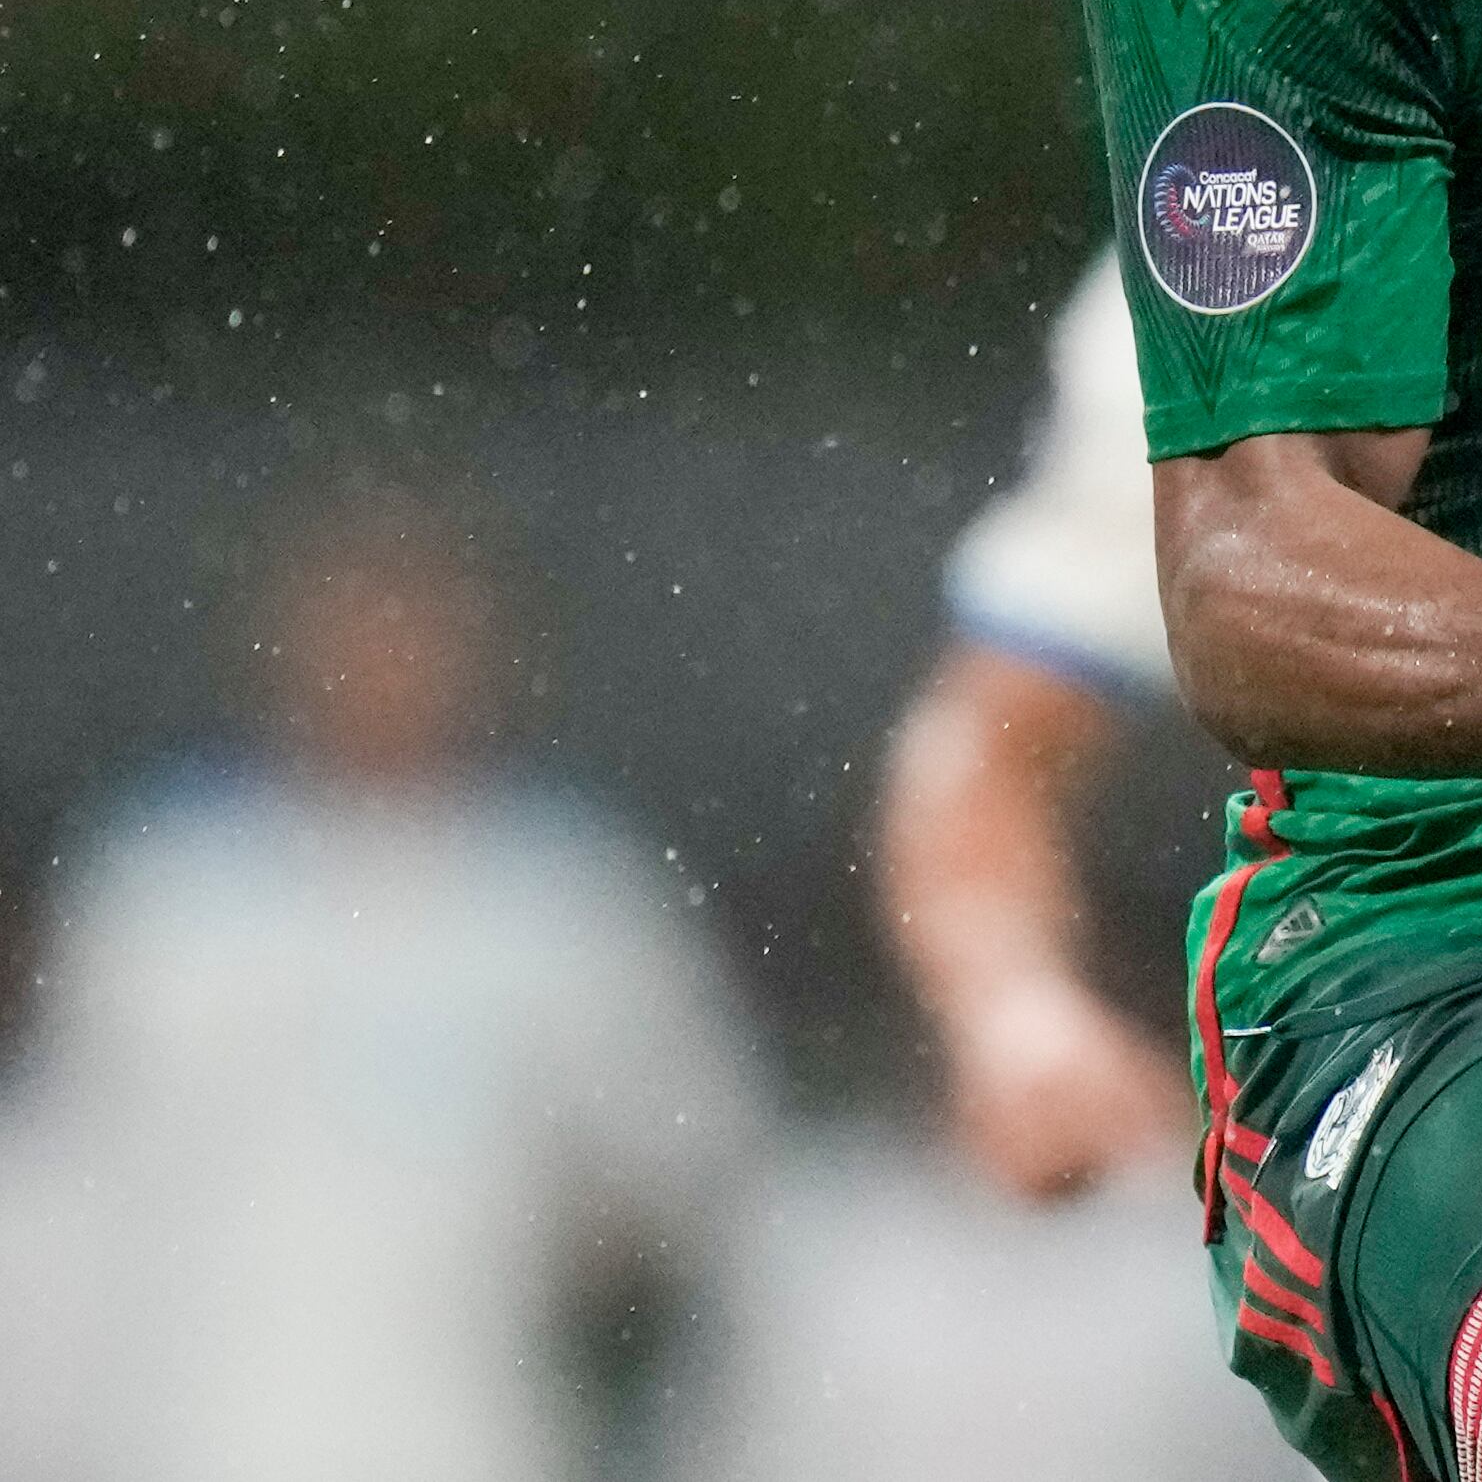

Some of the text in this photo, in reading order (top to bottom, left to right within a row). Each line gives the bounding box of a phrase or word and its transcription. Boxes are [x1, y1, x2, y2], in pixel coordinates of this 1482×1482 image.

[1200, 168, 1258, 185] Concacaf
[1183, 180, 1277, 214] NATIONS
[1212, 204, 1301, 234] LEAGUE
[1247, 232, 1285, 247] QATAR
